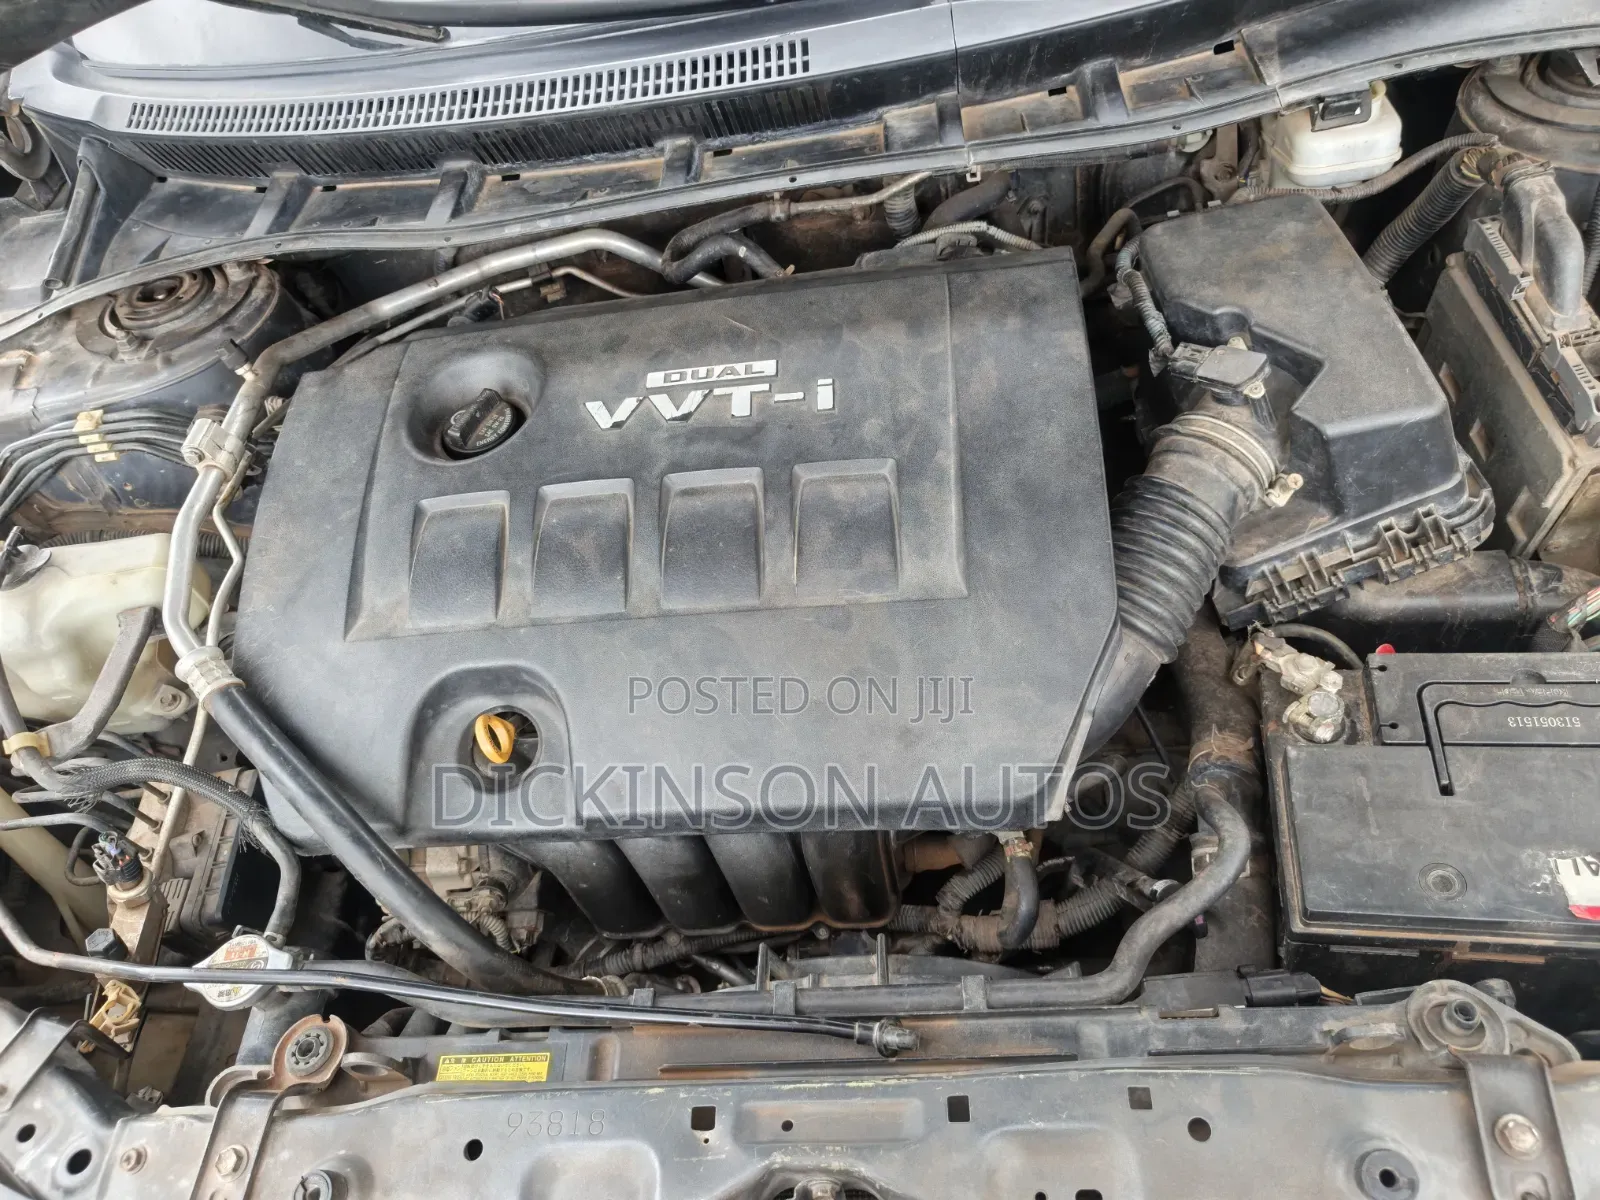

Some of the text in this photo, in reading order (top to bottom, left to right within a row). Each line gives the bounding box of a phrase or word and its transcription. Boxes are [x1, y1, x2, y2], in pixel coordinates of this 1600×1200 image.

[662, 363, 765, 384] DUAL
[476, 433, 498, 446] ENERGY
[507, 1109, 605, 1138] 93818
